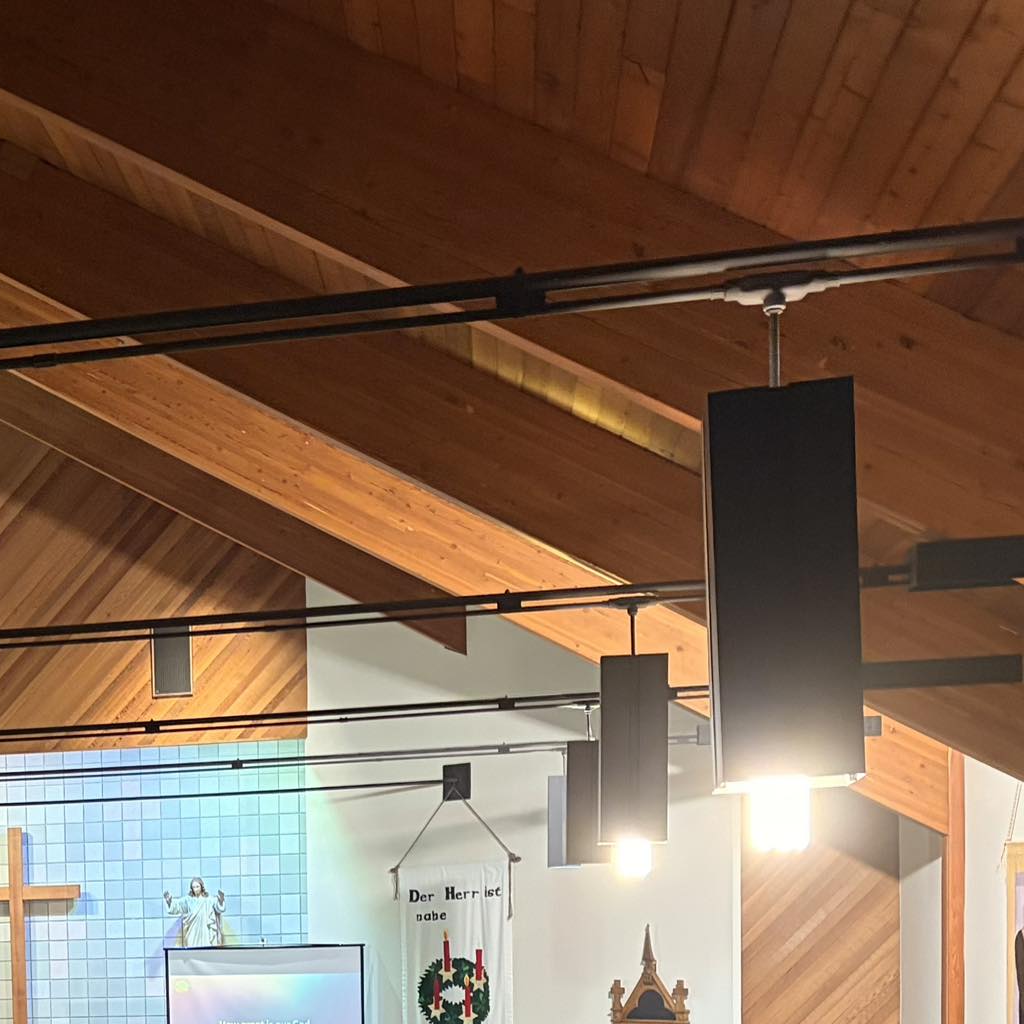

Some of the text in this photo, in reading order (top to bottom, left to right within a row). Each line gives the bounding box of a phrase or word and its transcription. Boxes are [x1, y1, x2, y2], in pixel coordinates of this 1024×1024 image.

[409, 886, 502, 903] Der Herr ist
